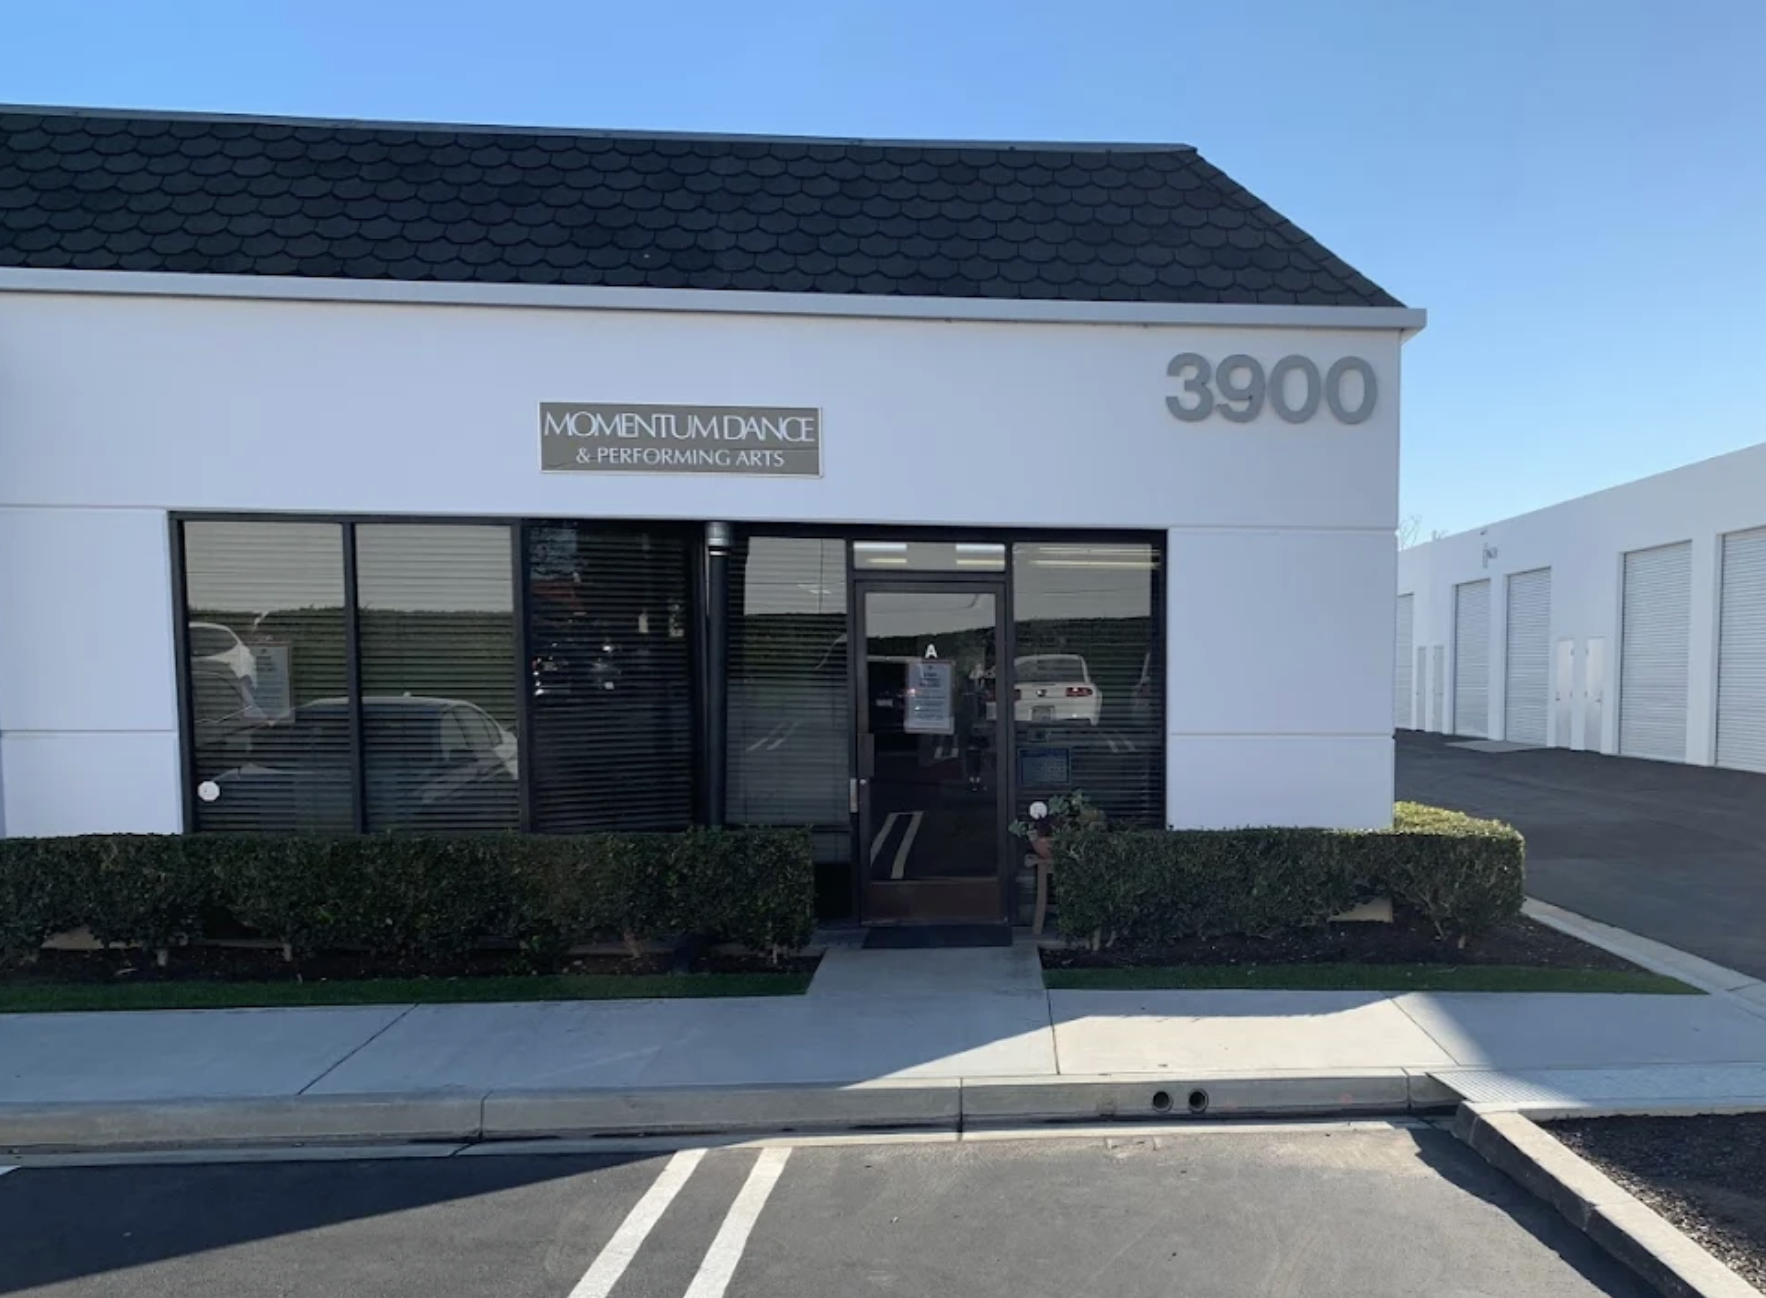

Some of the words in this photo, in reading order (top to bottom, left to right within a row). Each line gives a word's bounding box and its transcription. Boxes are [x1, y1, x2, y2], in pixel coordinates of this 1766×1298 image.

[1165, 352, 1378, 425] 3900
[544, 411, 719, 440] MOMENTUM
[723, 415, 815, 442] DANCE
[575, 448, 590, 464] &
[597, 448, 731, 466] PERFORMING
[735, 450, 785, 467] ARTS
[925, 644, 938, 658] A
